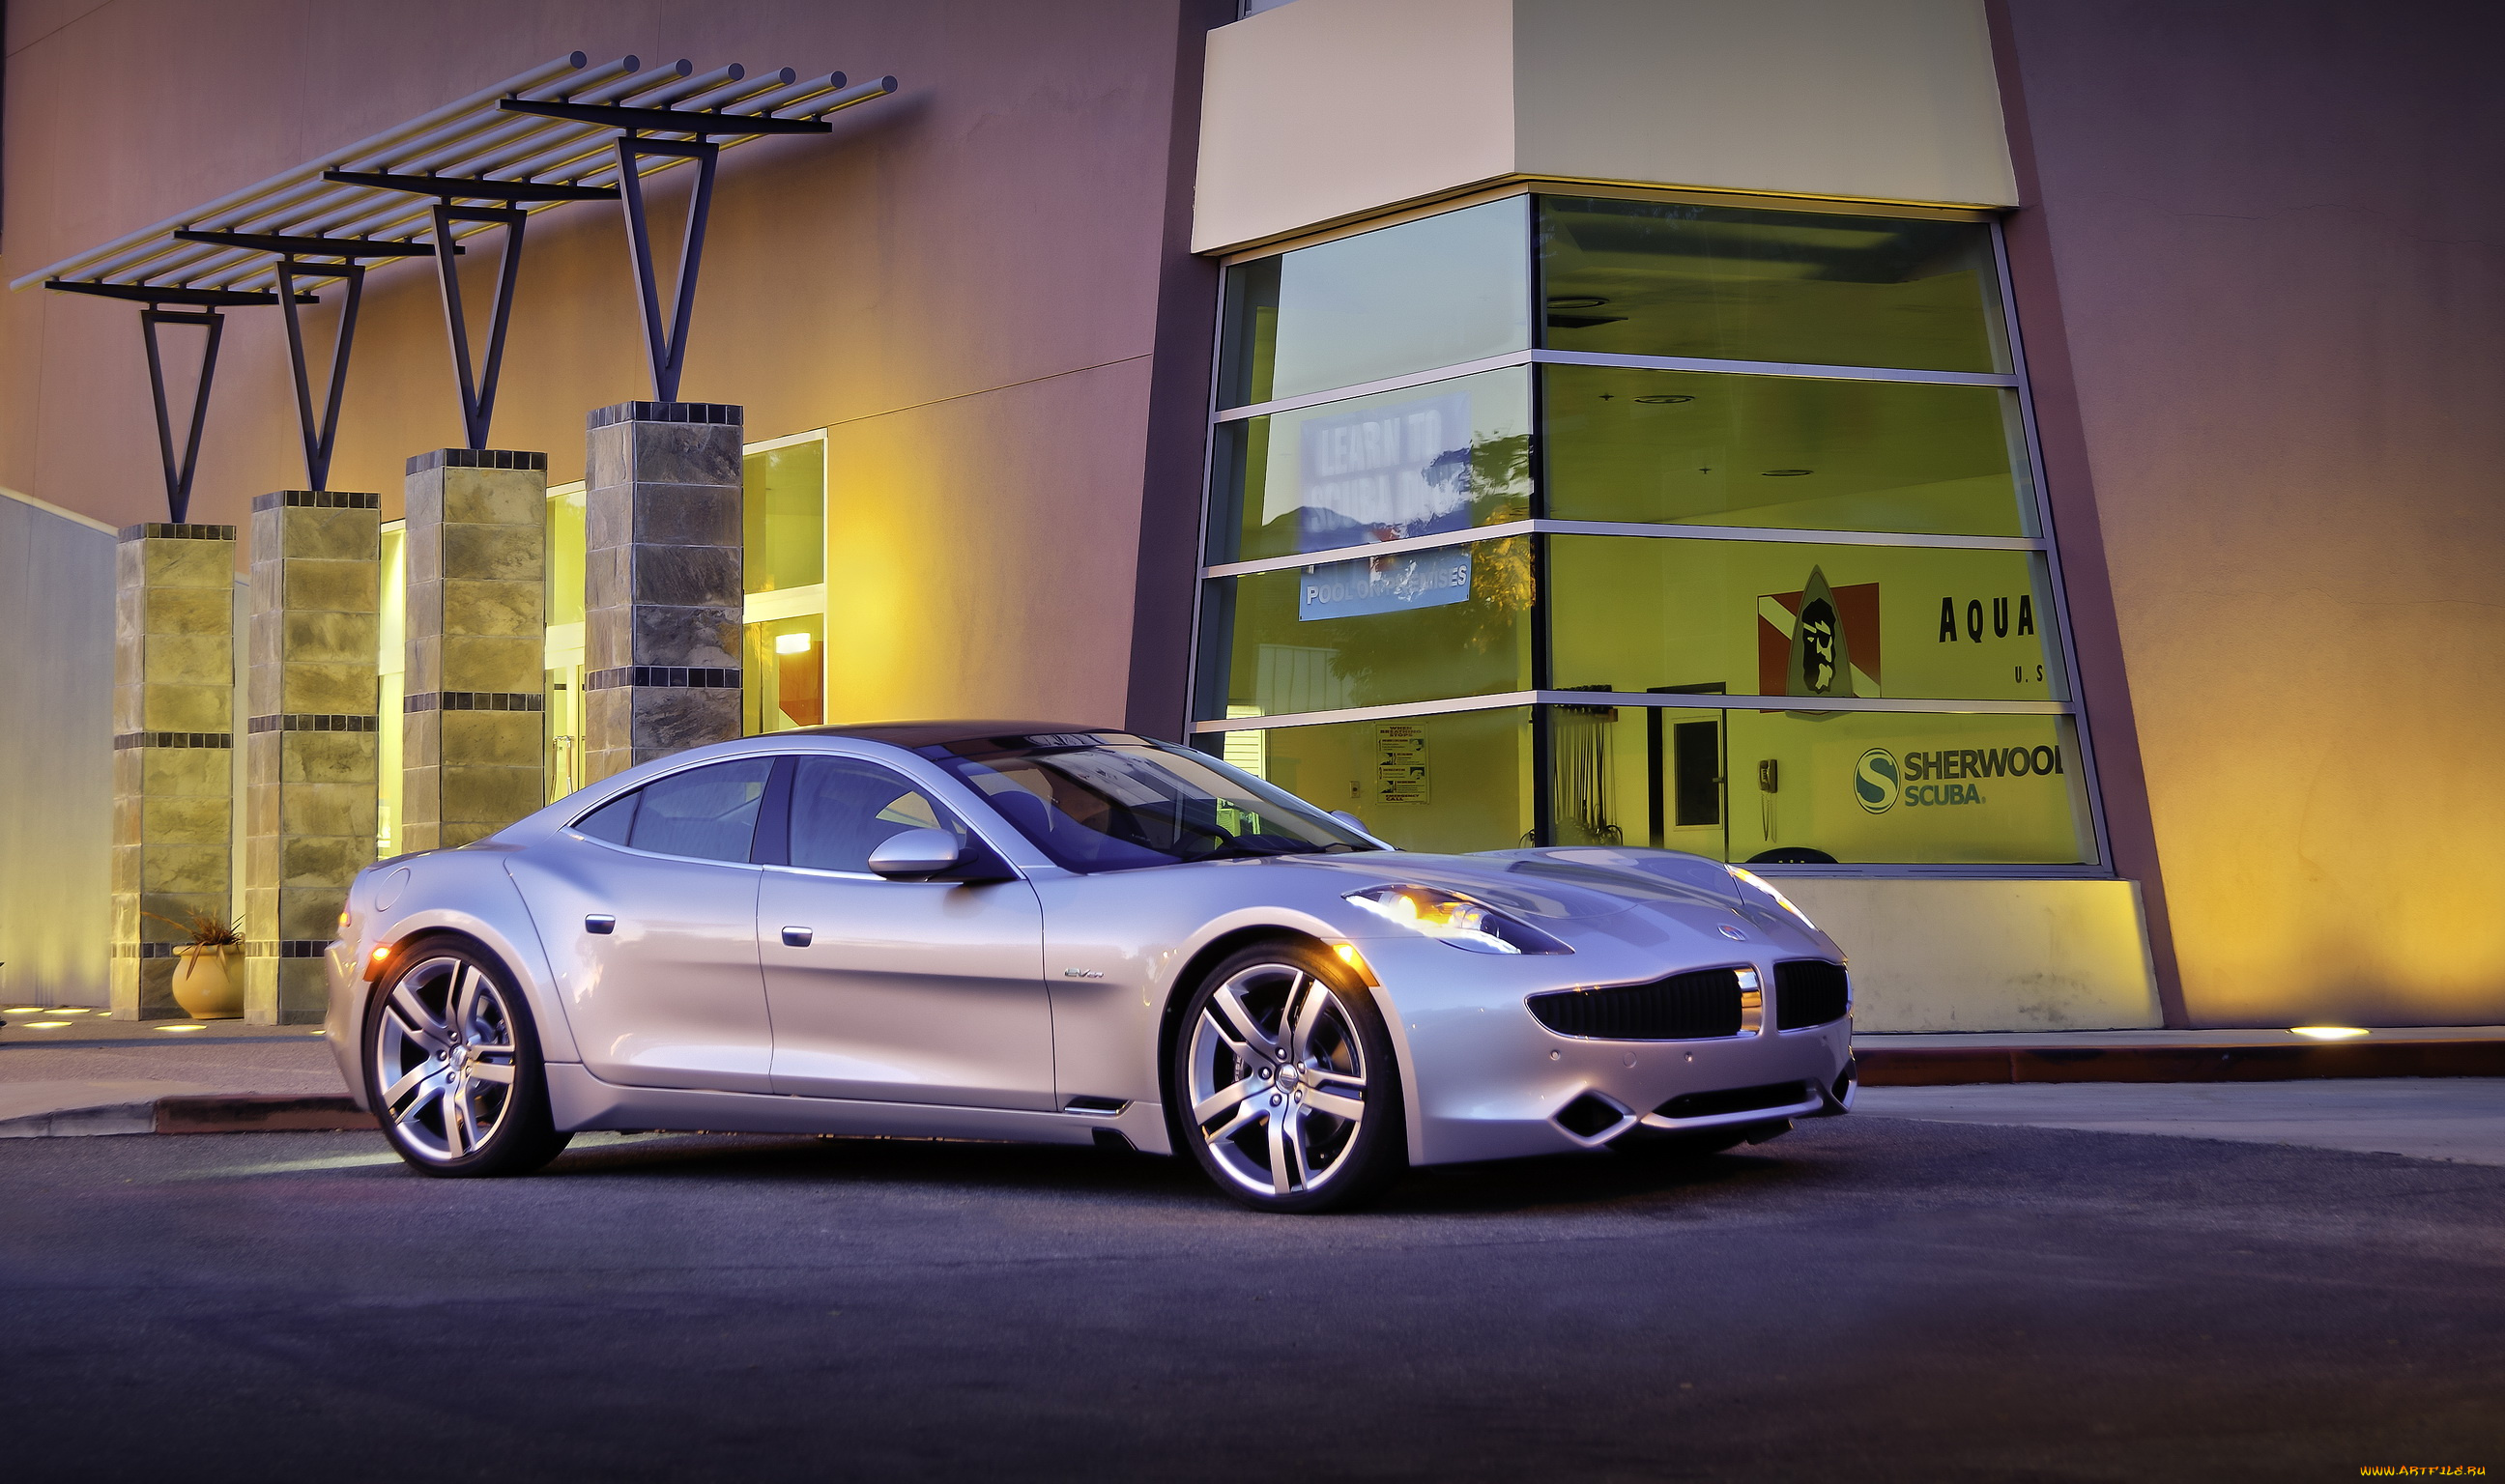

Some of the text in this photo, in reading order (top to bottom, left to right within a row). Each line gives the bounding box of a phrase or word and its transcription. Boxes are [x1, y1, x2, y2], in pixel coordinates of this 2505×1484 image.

[1321, 410, 1443, 477] LEARN TO
[1307, 584, 1353, 605] POOL
[1939, 595, 2034, 643] AQUA
[1904, 784, 1981, 807] SCUBA
